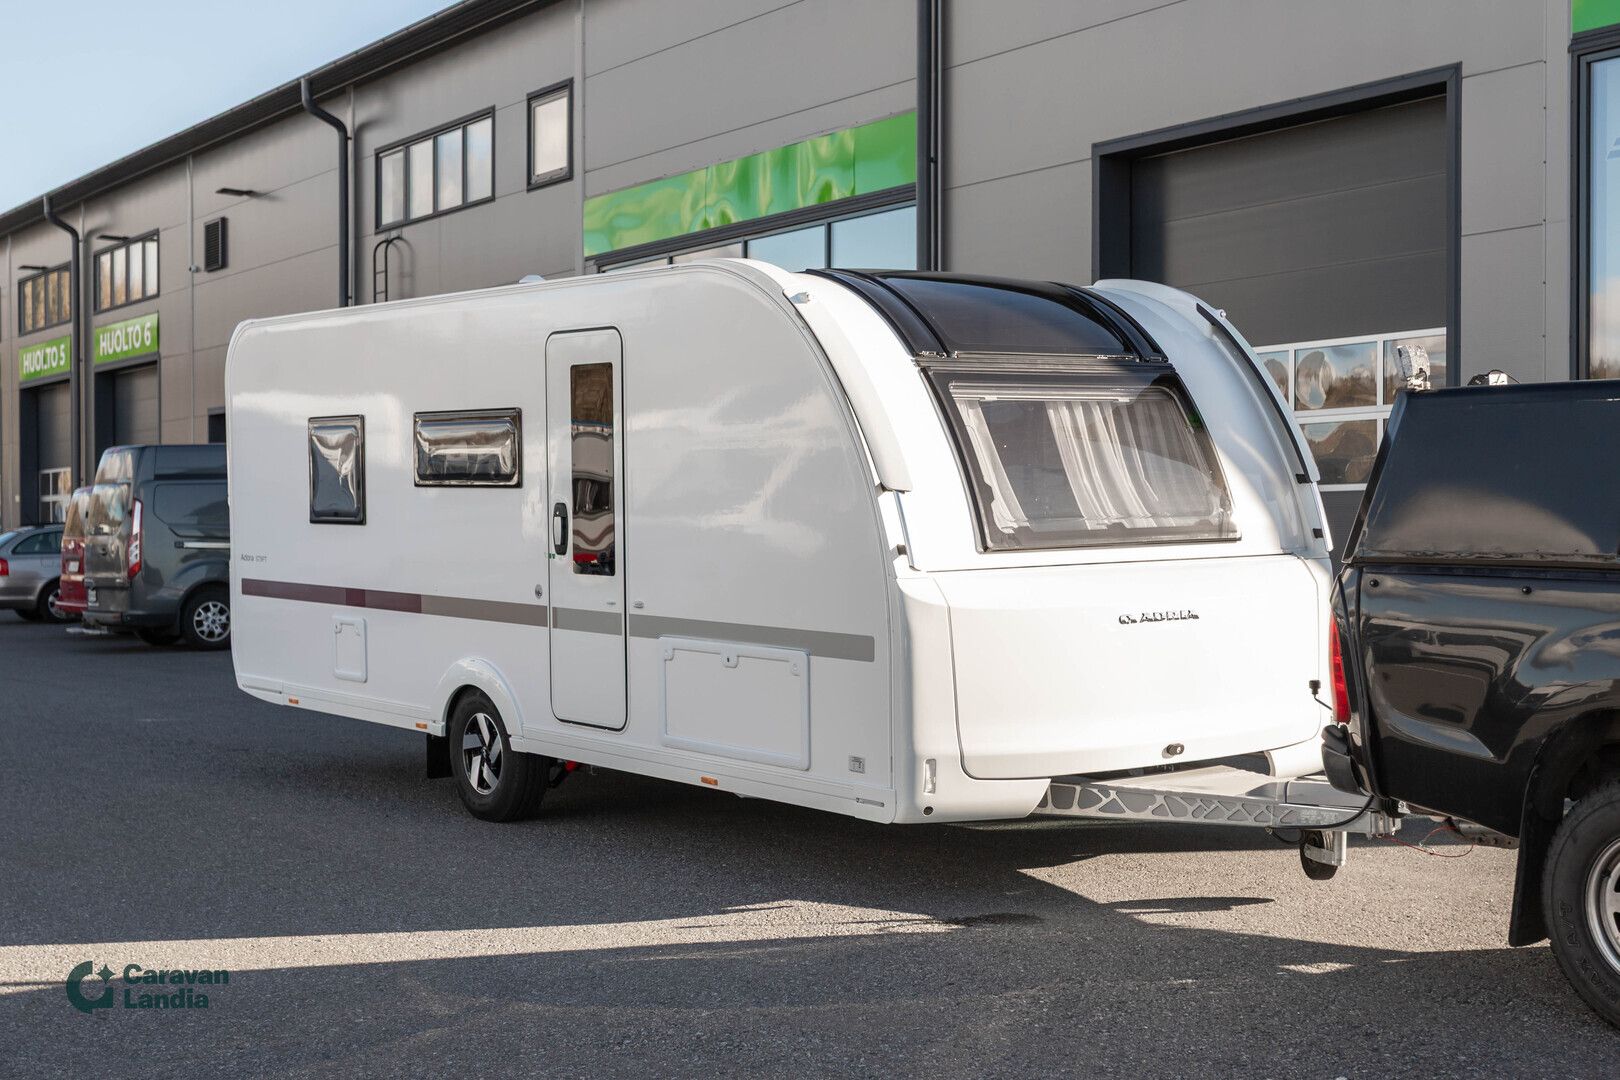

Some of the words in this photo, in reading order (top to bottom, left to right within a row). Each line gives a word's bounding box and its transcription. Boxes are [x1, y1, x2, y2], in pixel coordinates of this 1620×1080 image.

[100, 327, 141, 356] HUOLTO
[144, 322, 151, 346] 6
[23, 348, 59, 374] HUOLTO
[59, 344, 66, 366] 5
